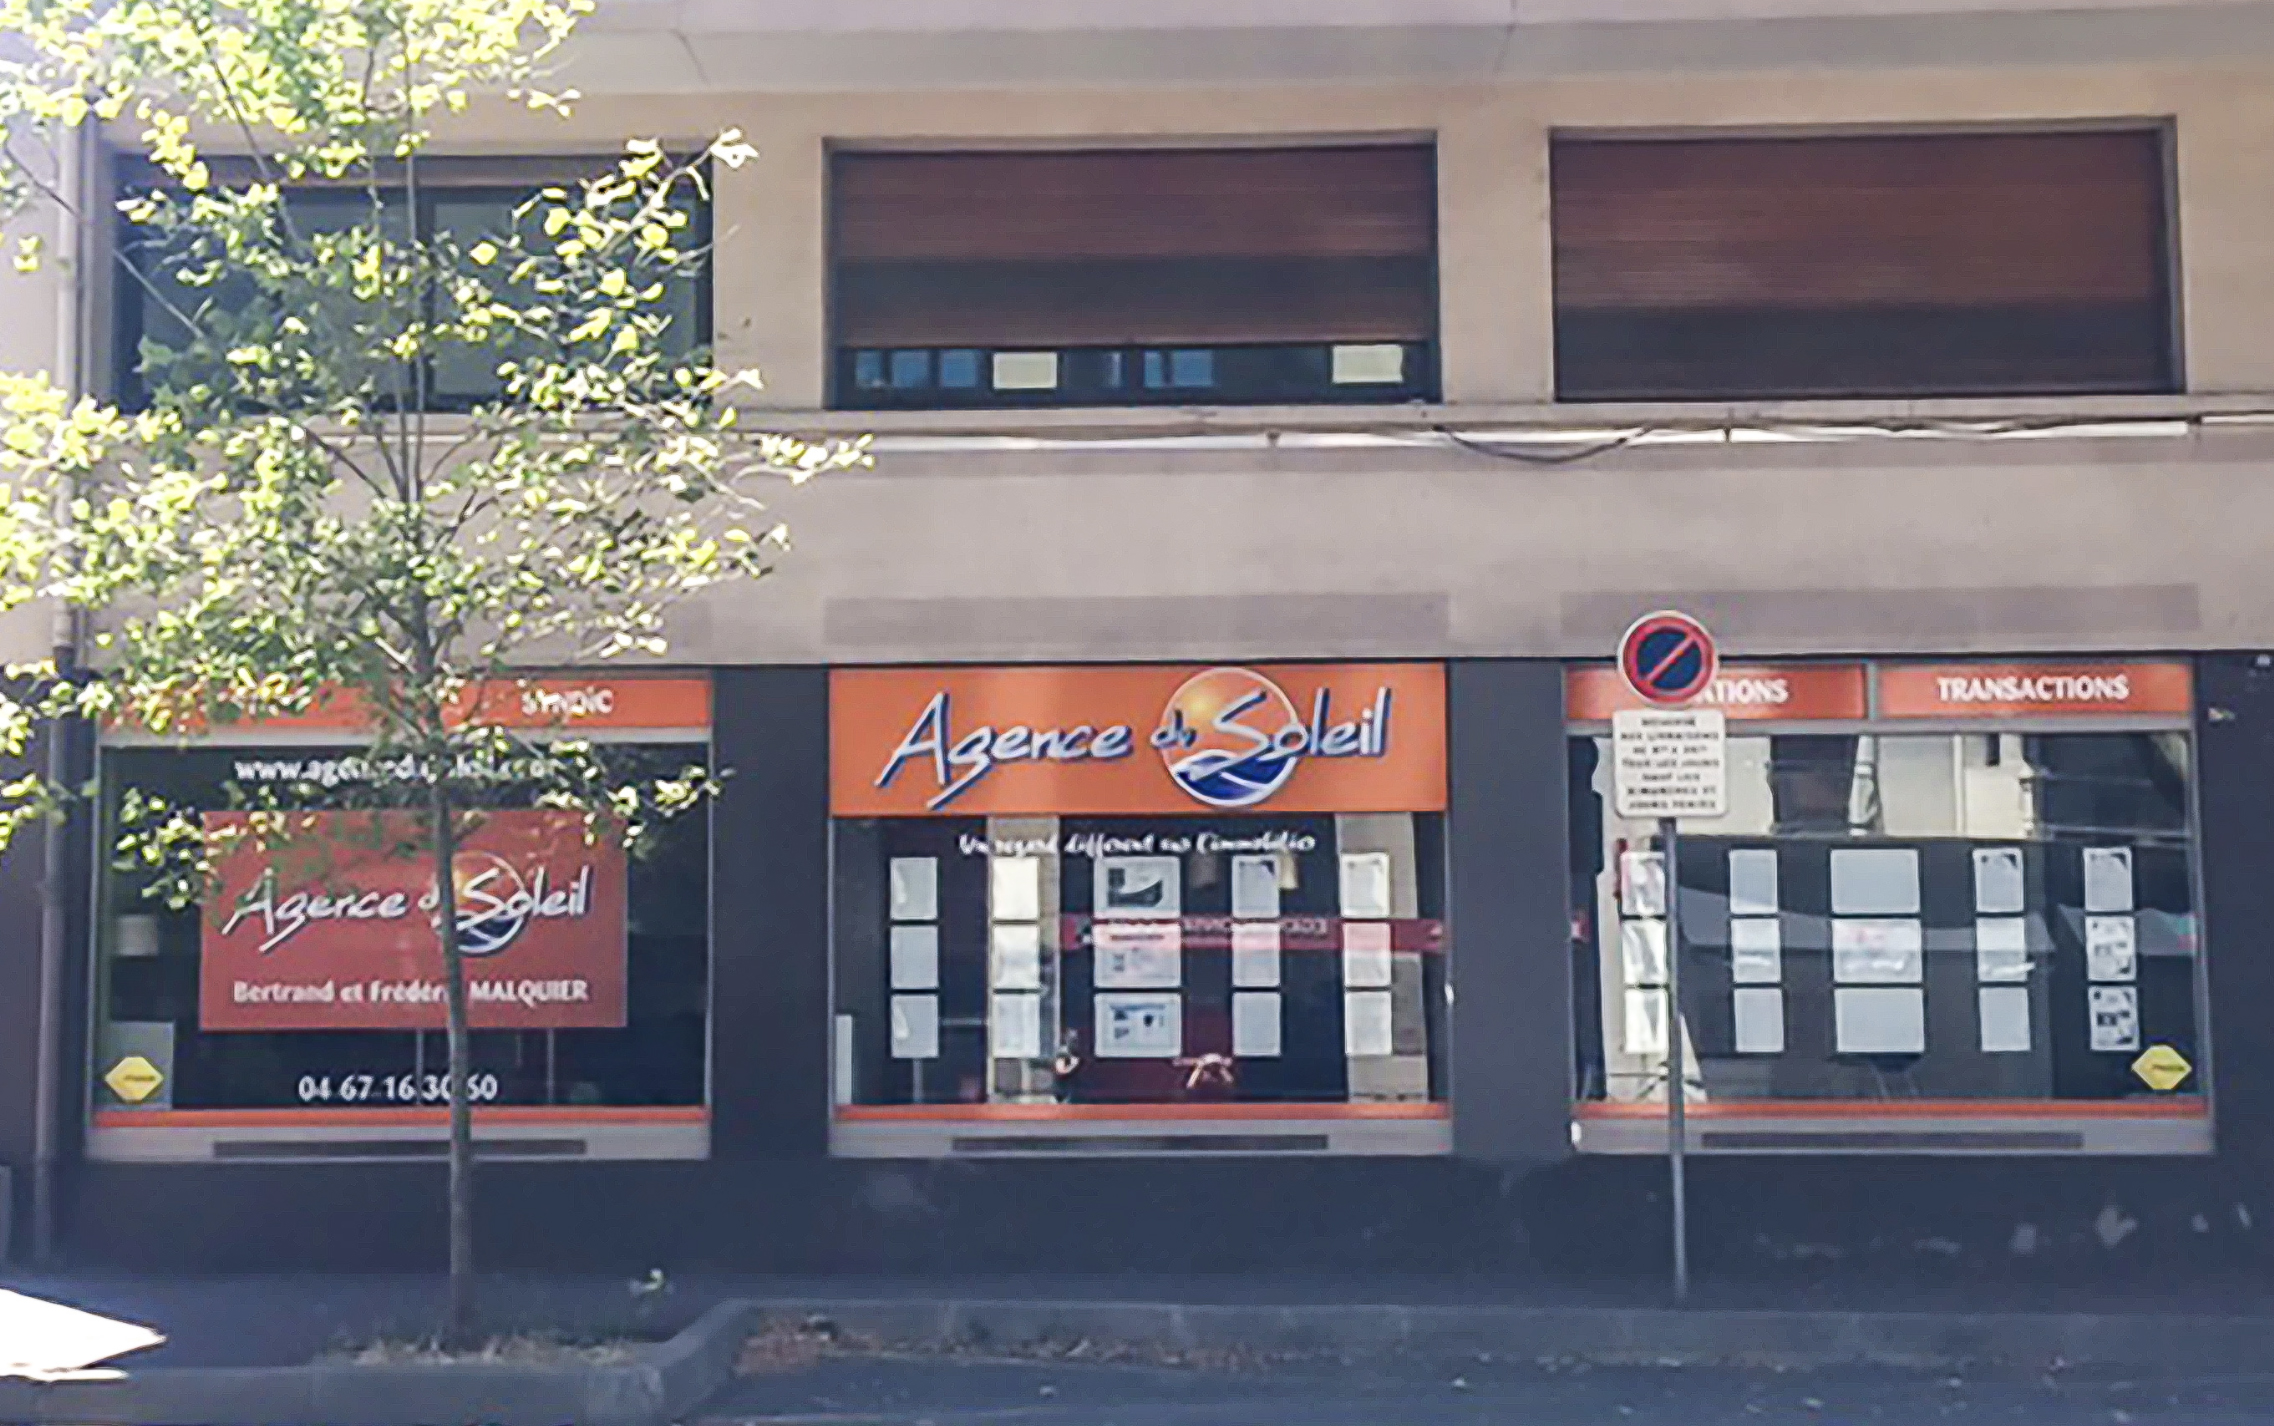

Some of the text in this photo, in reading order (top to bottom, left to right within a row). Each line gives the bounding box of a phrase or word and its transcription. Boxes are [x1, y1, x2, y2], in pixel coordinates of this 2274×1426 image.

[1935, 674, 2131, 702] TRANSACTIONS
[874, 690, 1134, 812] Agence
[1180, 685, 1393, 783] Soleil
[221, 864, 407, 953] Agence
[455, 863, 591, 933] Soleil
[467, 978, 590, 1008] MALQUIER
[339, 1073, 375, 1102] 67
[382, 1073, 417, 1101] 16
